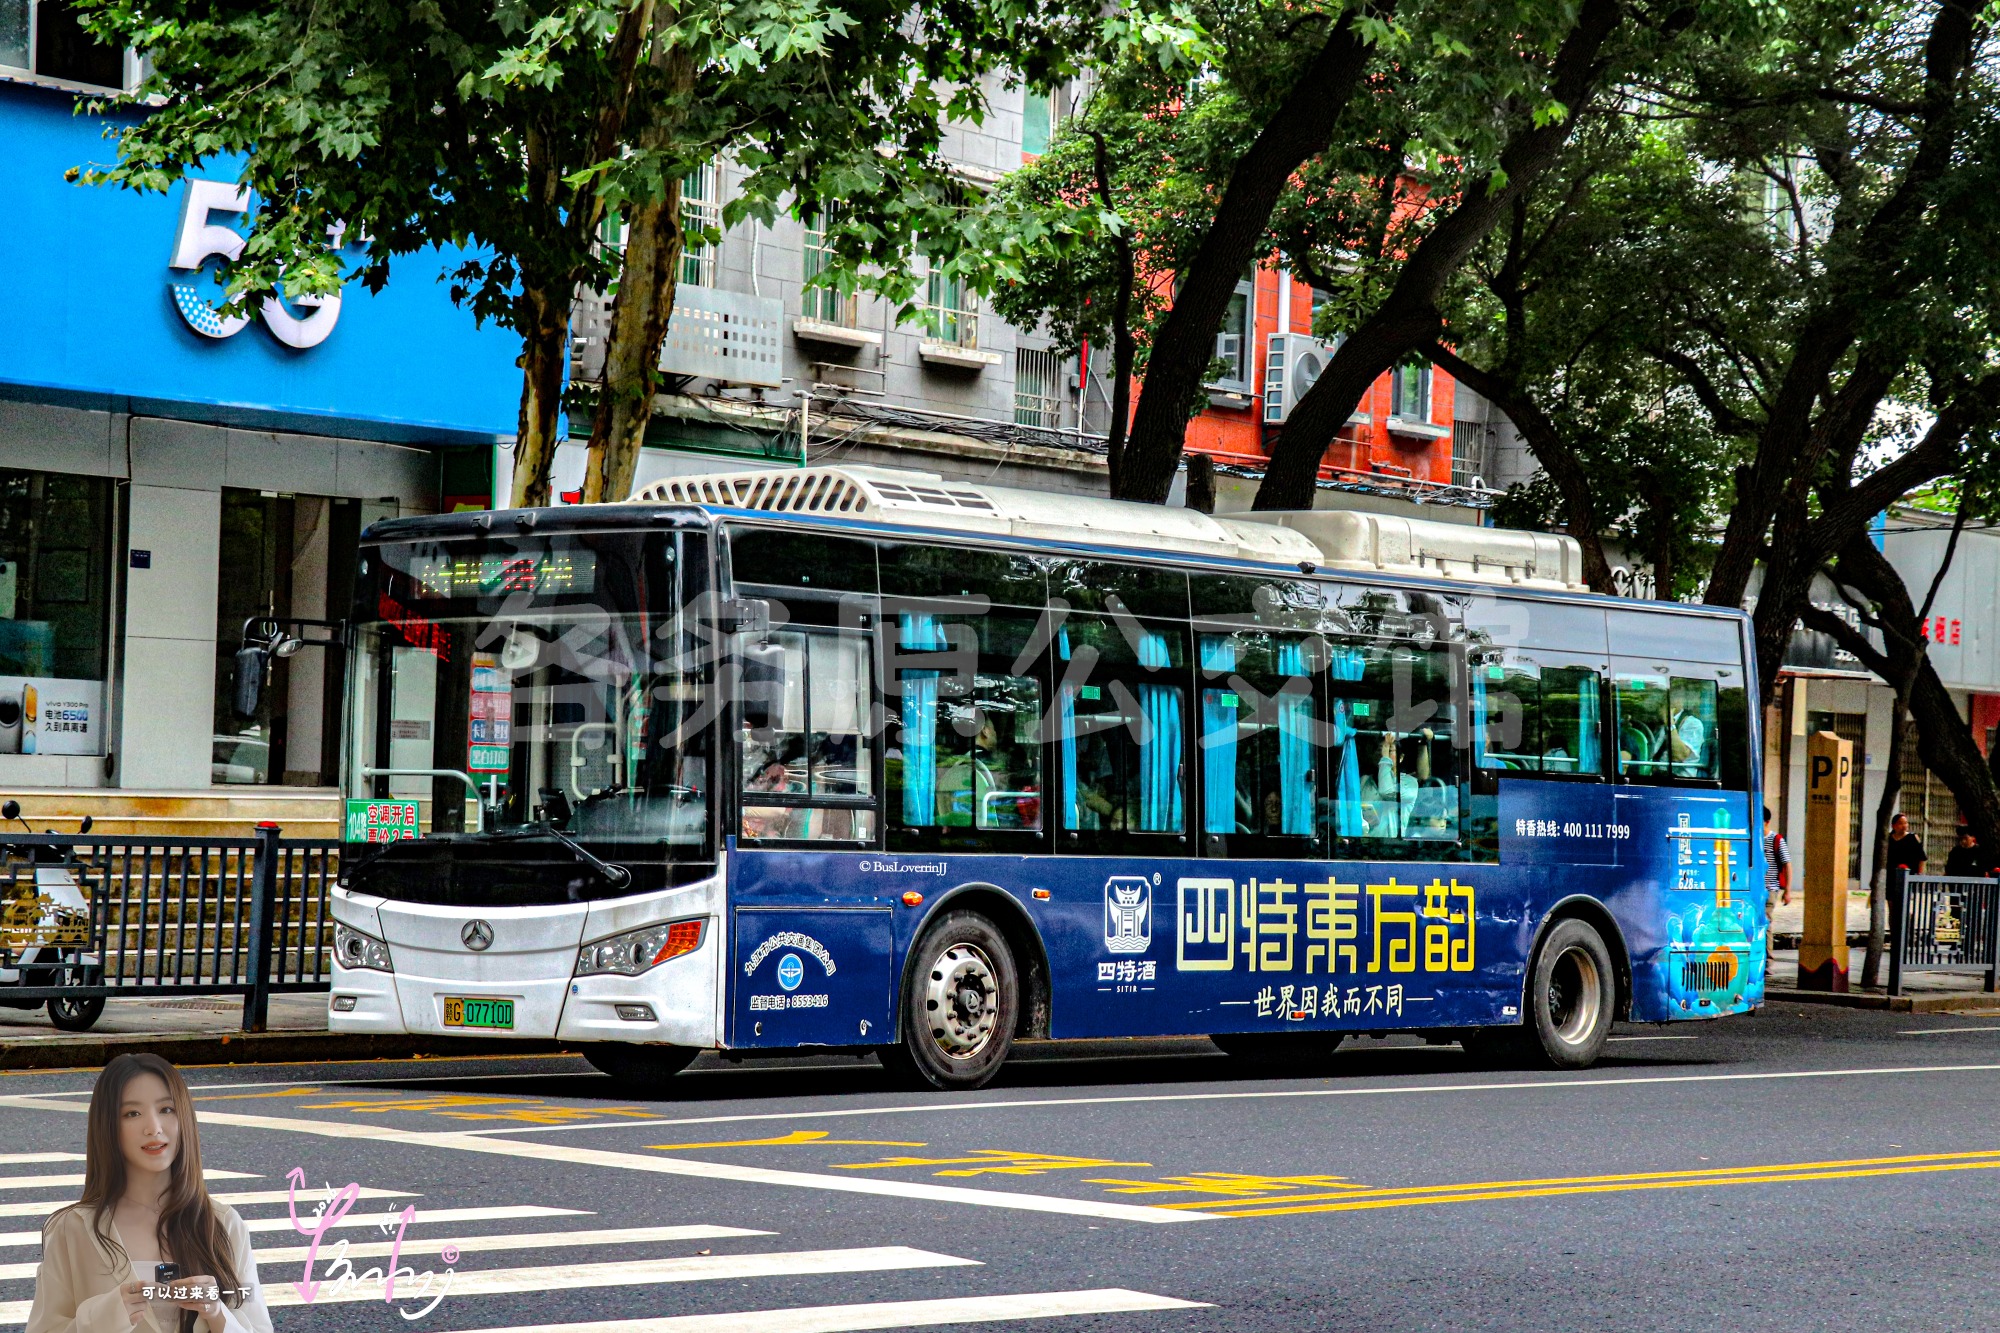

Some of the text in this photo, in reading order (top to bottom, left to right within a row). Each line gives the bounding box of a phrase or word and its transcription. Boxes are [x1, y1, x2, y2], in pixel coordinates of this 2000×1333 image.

[45, 710, 88, 721] 电池6500
[45, 722, 88, 733] 久到真离谱
[1812, 756, 1833, 789] P
[1840, 757, 1849, 789] P
[367, 804, 415, 827] 空调开启
[1563, 822, 1582, 837] 400
[1584, 823, 1603, 838] 111
[1605, 824, 1630, 840] 7999
[745, 932, 836, 976] 九江市公共交通集团公司
[1098, 960, 1157, 982] 四特酒
[1253, 983, 1403, 1021] 世界因我而不同
